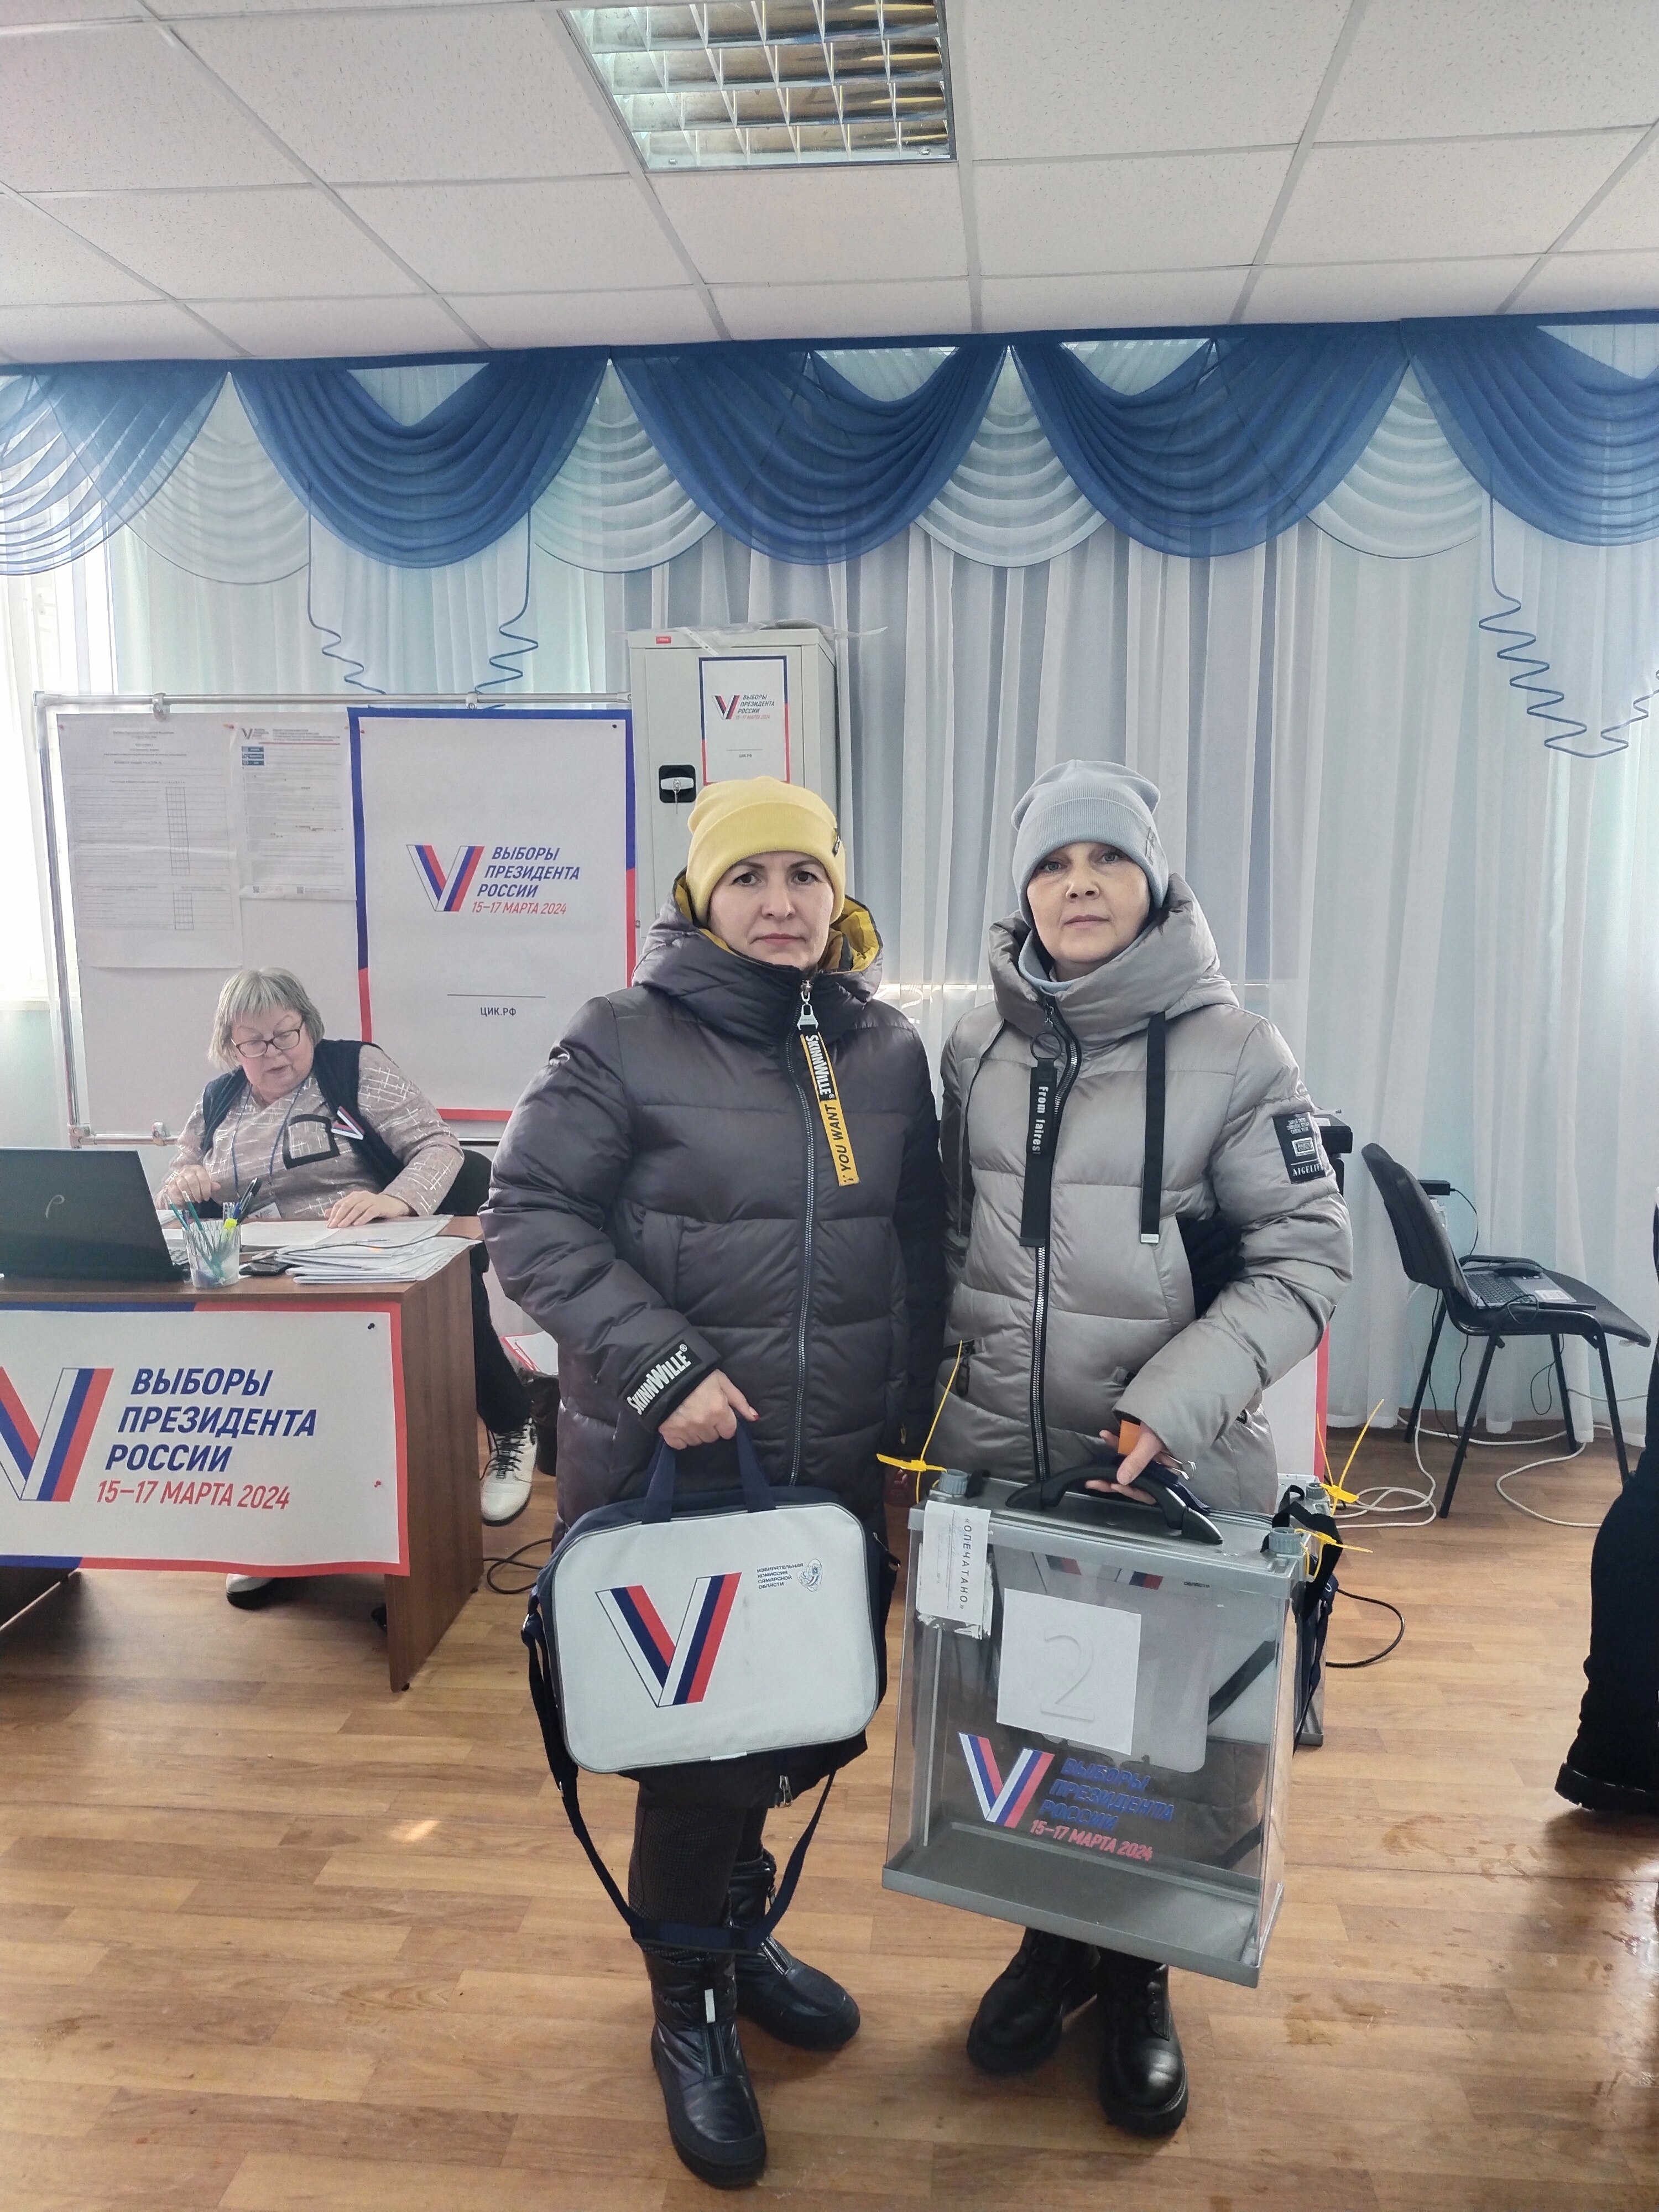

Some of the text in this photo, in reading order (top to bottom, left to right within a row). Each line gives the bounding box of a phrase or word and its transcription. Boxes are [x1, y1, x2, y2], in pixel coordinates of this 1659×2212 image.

[492, 847, 560, 860] ВЫБОРЫ
[484, 865, 580, 881] ПРЕЗИДЕНТА
[477, 884, 539, 898] РОССИИ
[502, 902, 539, 914] МАРТА
[540, 903, 567, 915] 2024
[480, 1007, 517, 1016] ЦИК.РФ
[824, 1104, 844, 1140] WANT
[836, 1144, 852, 1172] YOU
[130, 1368, 274, 1396] ВЫБОРЫ
[117, 1406, 317, 1439] ПРЕЗИДЕНТА
[105, 1444, 233, 1473] РОССИИ
[160, 1481, 234, 1507] МАРТА
[237, 1484, 290, 1510] 2024
[757, 1563, 804, 1573] ИЗБИРАТЕЛЬНАЯ
[758, 1574, 792, 1584] САМАРСКОЙ
[1039, 1624, 1095, 1723] 2
[1061, 1757, 1151, 1792] ВЫБОРЫ
[1049, 1778, 1175, 1822] ПРЕЗИДЕНТА
[1039, 1799, 1119, 1833] РОССИИ
[1068, 1829, 1118, 1853] МАРТА
[1117, 1840, 1153, 1861] 2024
